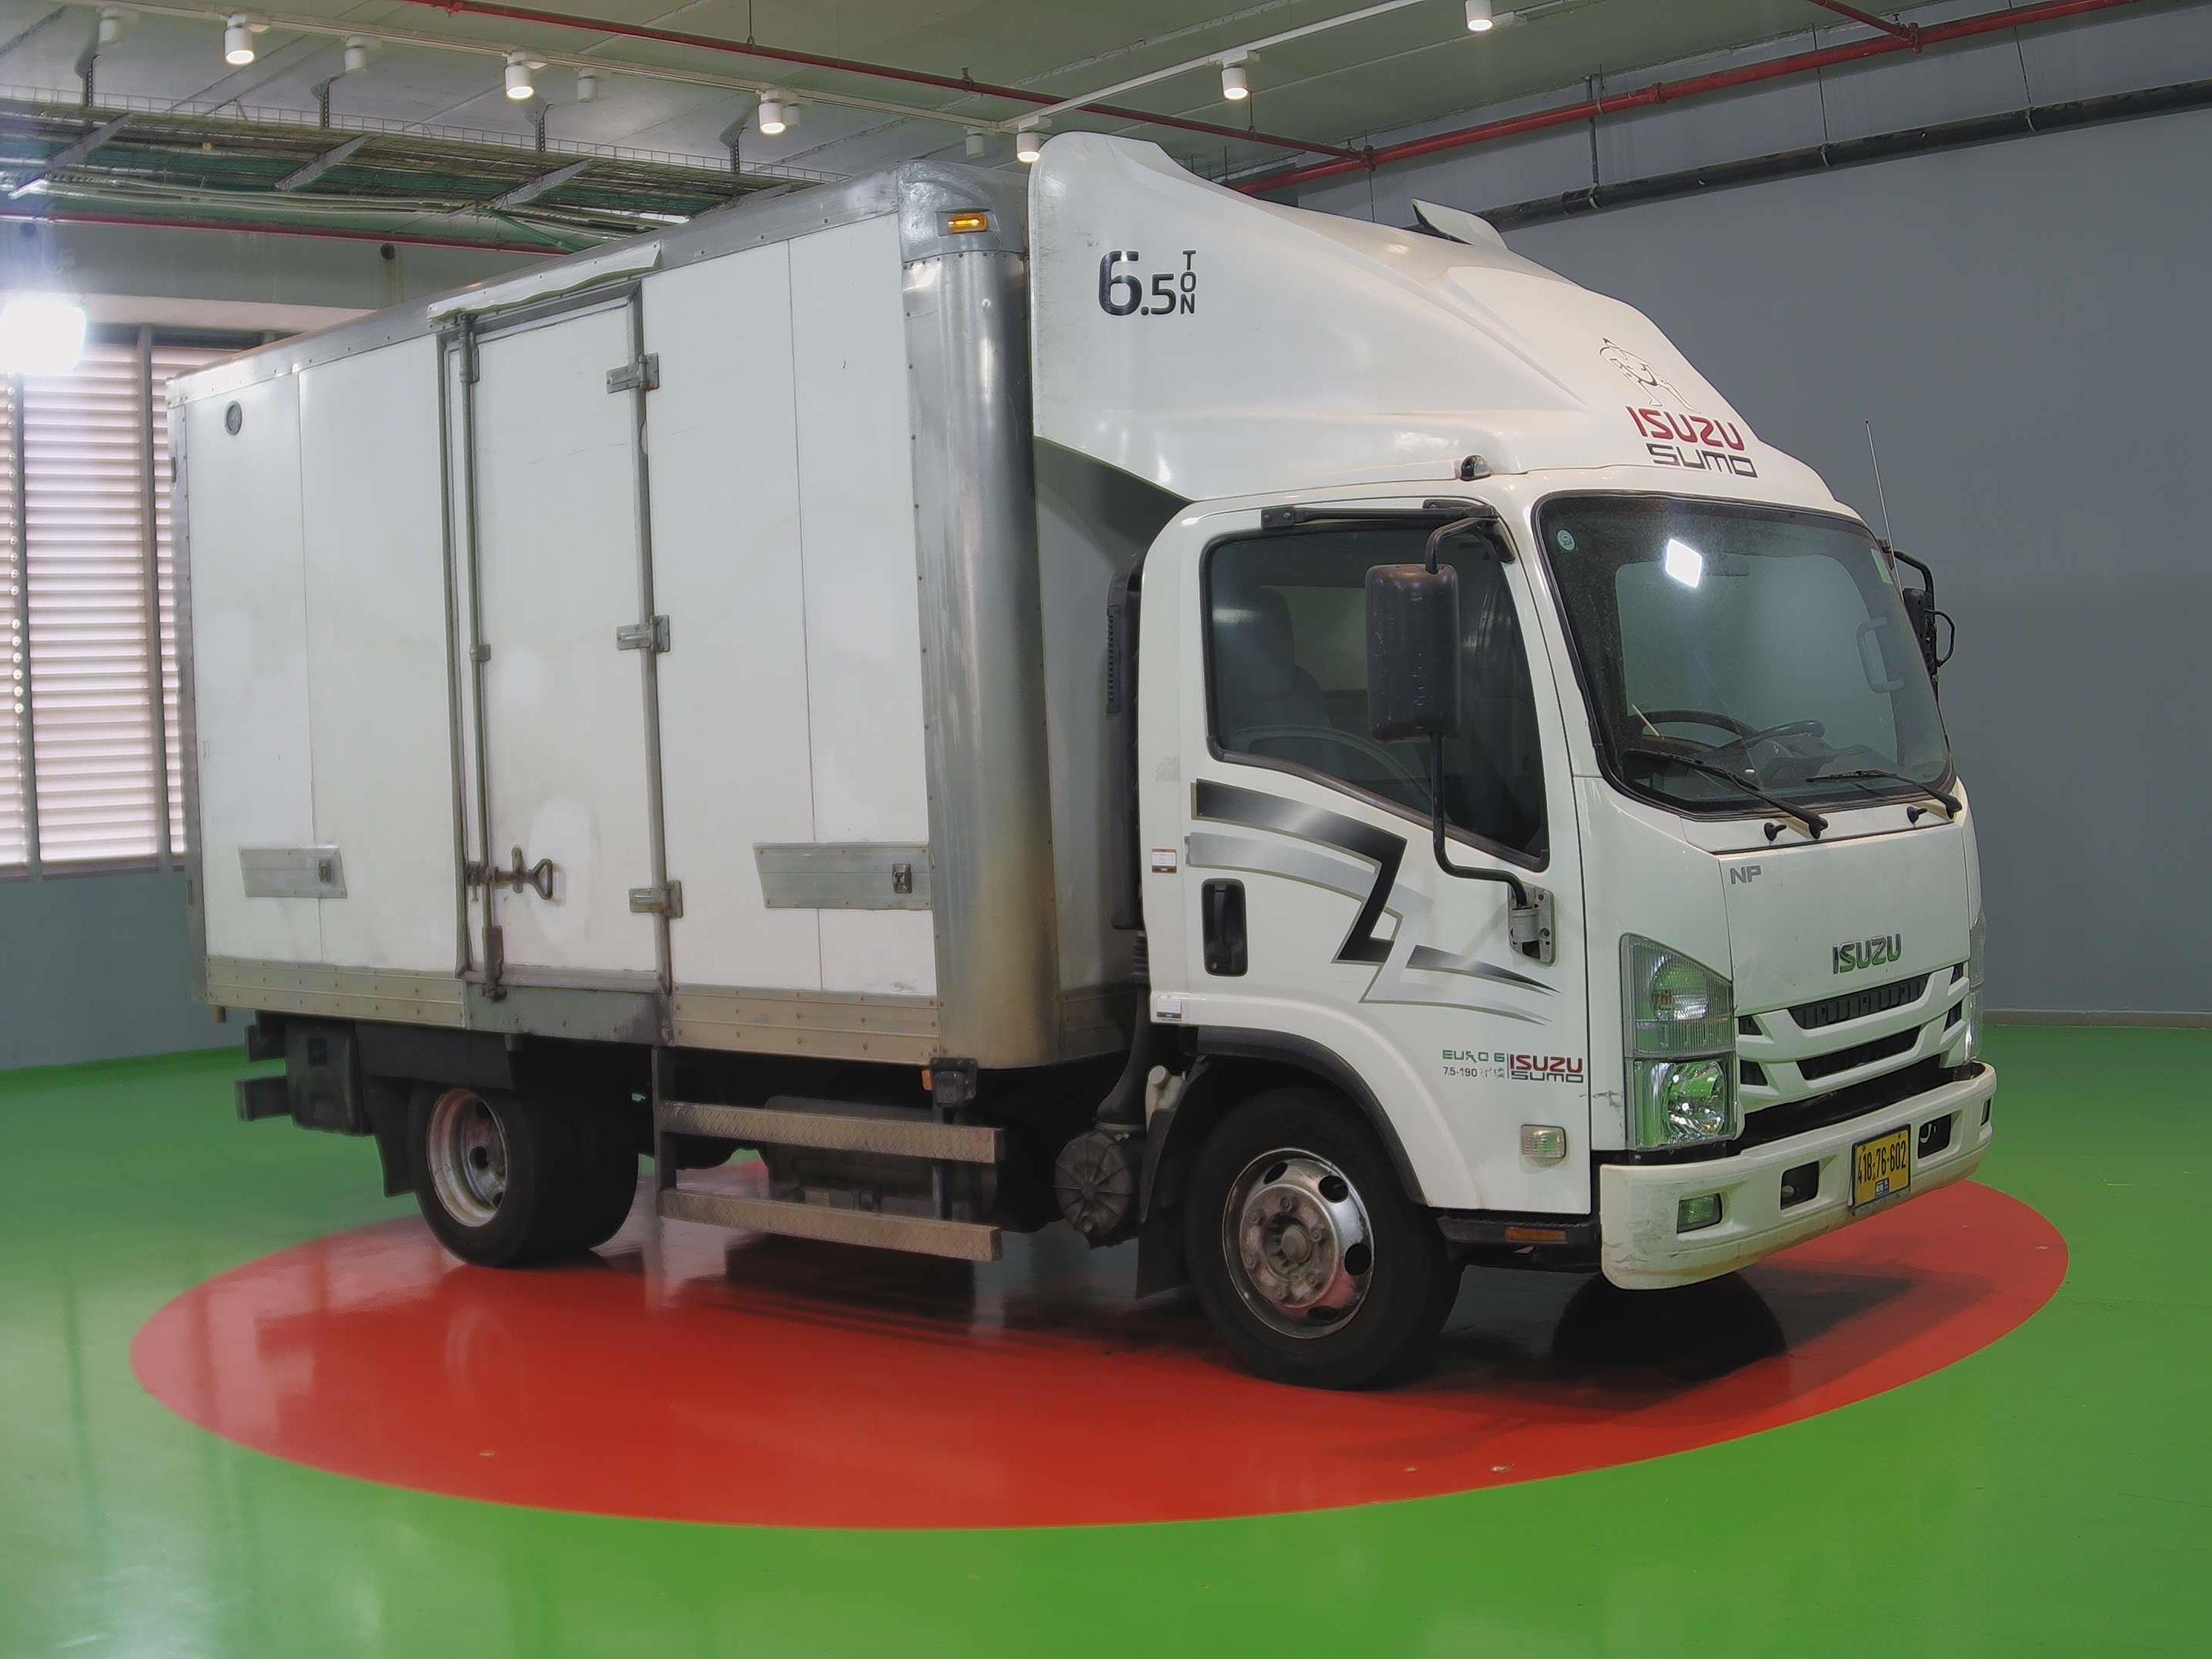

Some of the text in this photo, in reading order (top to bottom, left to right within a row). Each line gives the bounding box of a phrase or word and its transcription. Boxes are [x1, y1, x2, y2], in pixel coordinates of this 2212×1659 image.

[1099, 250, 1176, 316] 6.5
[1181, 250, 1196, 314] TON
[1625, 406, 1745, 451] ISUZU
[1645, 442, 1758, 478] SUMO
[1730, 865, 1762, 884] NP
[1832, 933, 1902, 975] ISUZU
[1442, 1049, 1505, 1063] EURO 6
[1510, 1054, 1583, 1074] ISUZU
[1511, 1071, 1584, 1084] SUMO
